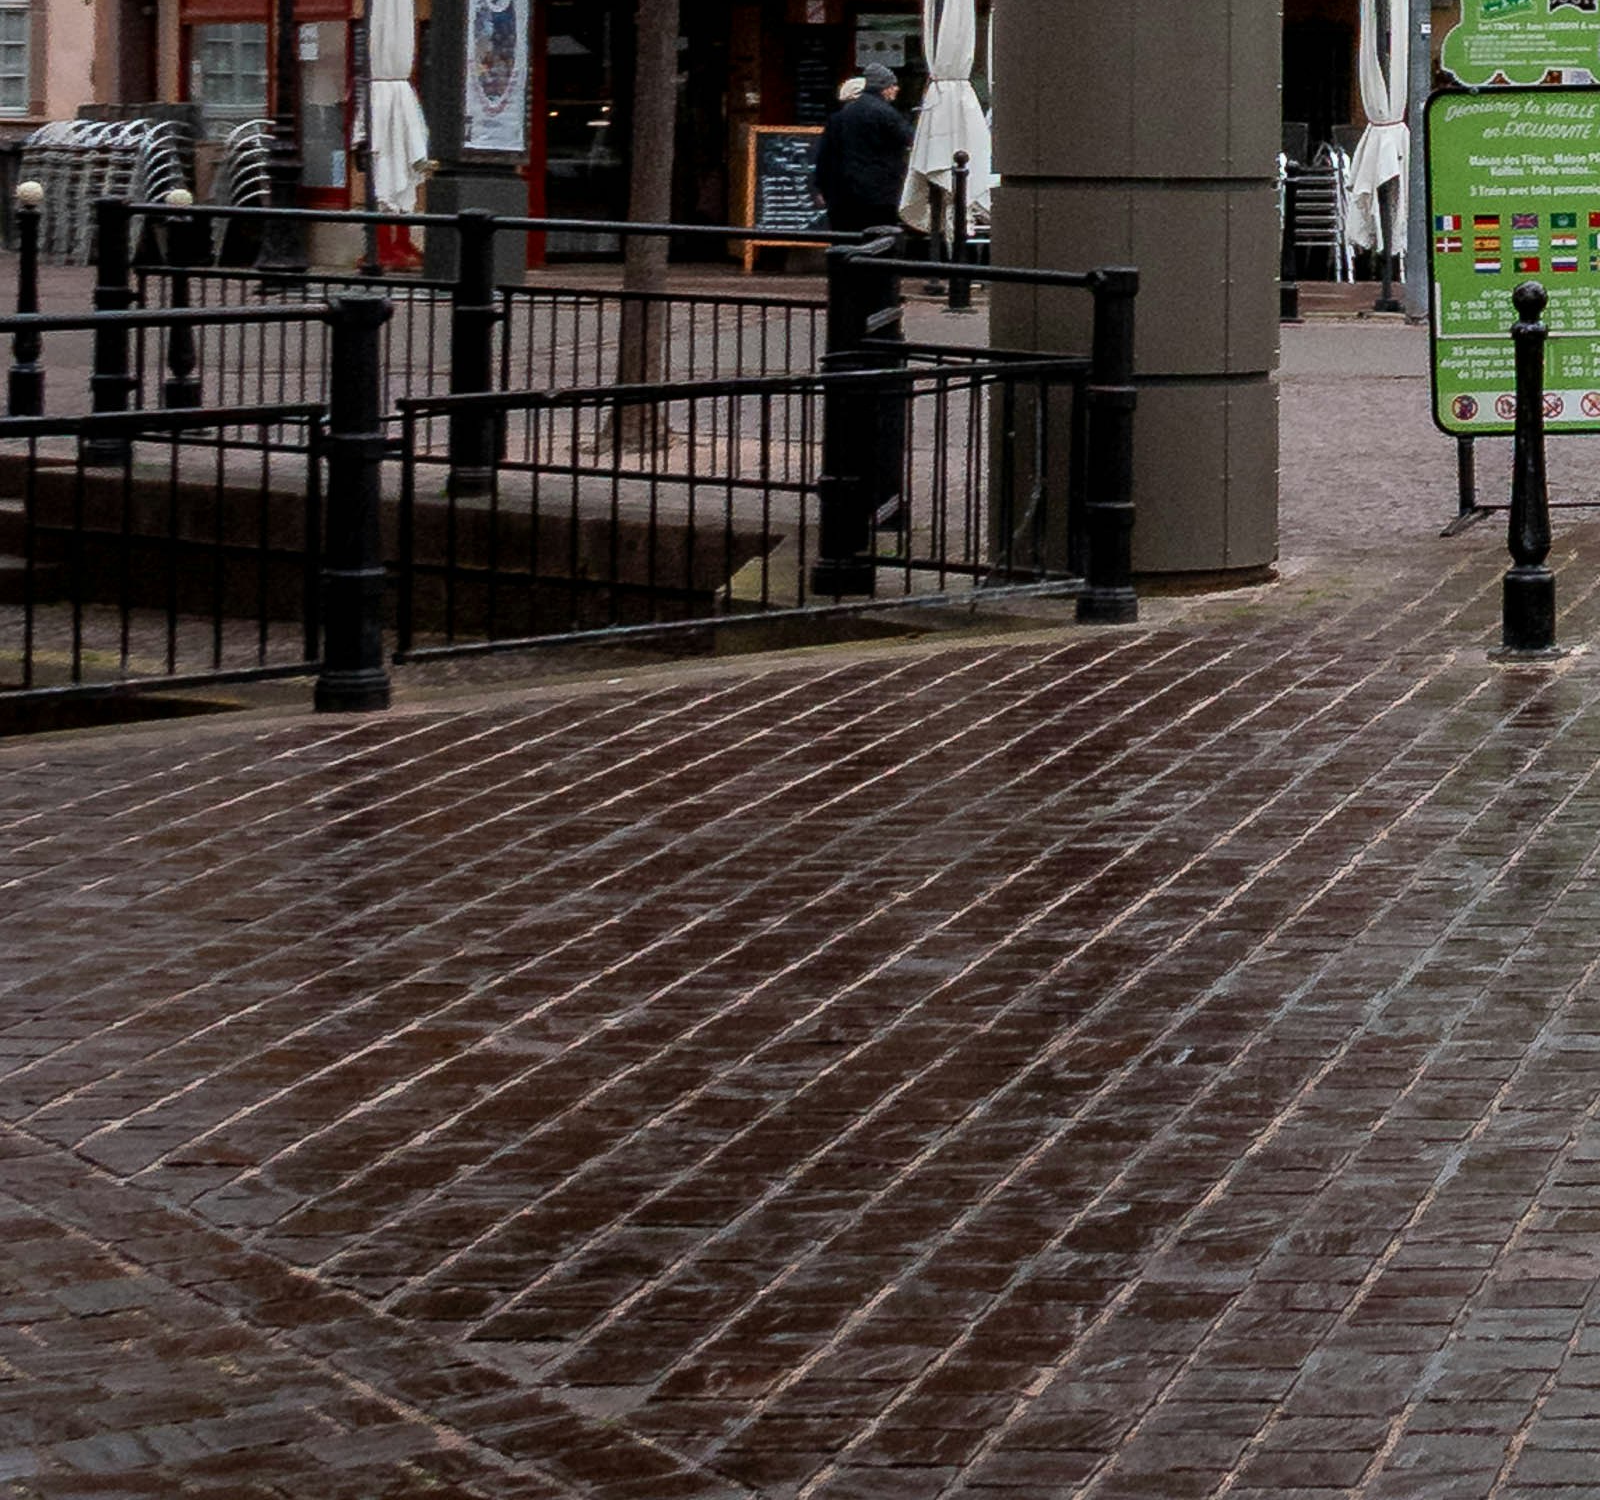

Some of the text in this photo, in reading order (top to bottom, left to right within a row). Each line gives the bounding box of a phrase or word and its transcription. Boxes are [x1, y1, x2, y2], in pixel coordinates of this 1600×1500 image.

[1524, 100, 1540, 115] la
[1545, 102, 1595, 119] VIEILLE
[1482, 126, 1499, 138] en
[1469, 155, 1501, 167] Maison
[1503, 155, 1520, 166] des
[1553, 153, 1586, 165] Maison
[1508, 186, 1528, 196] avec
